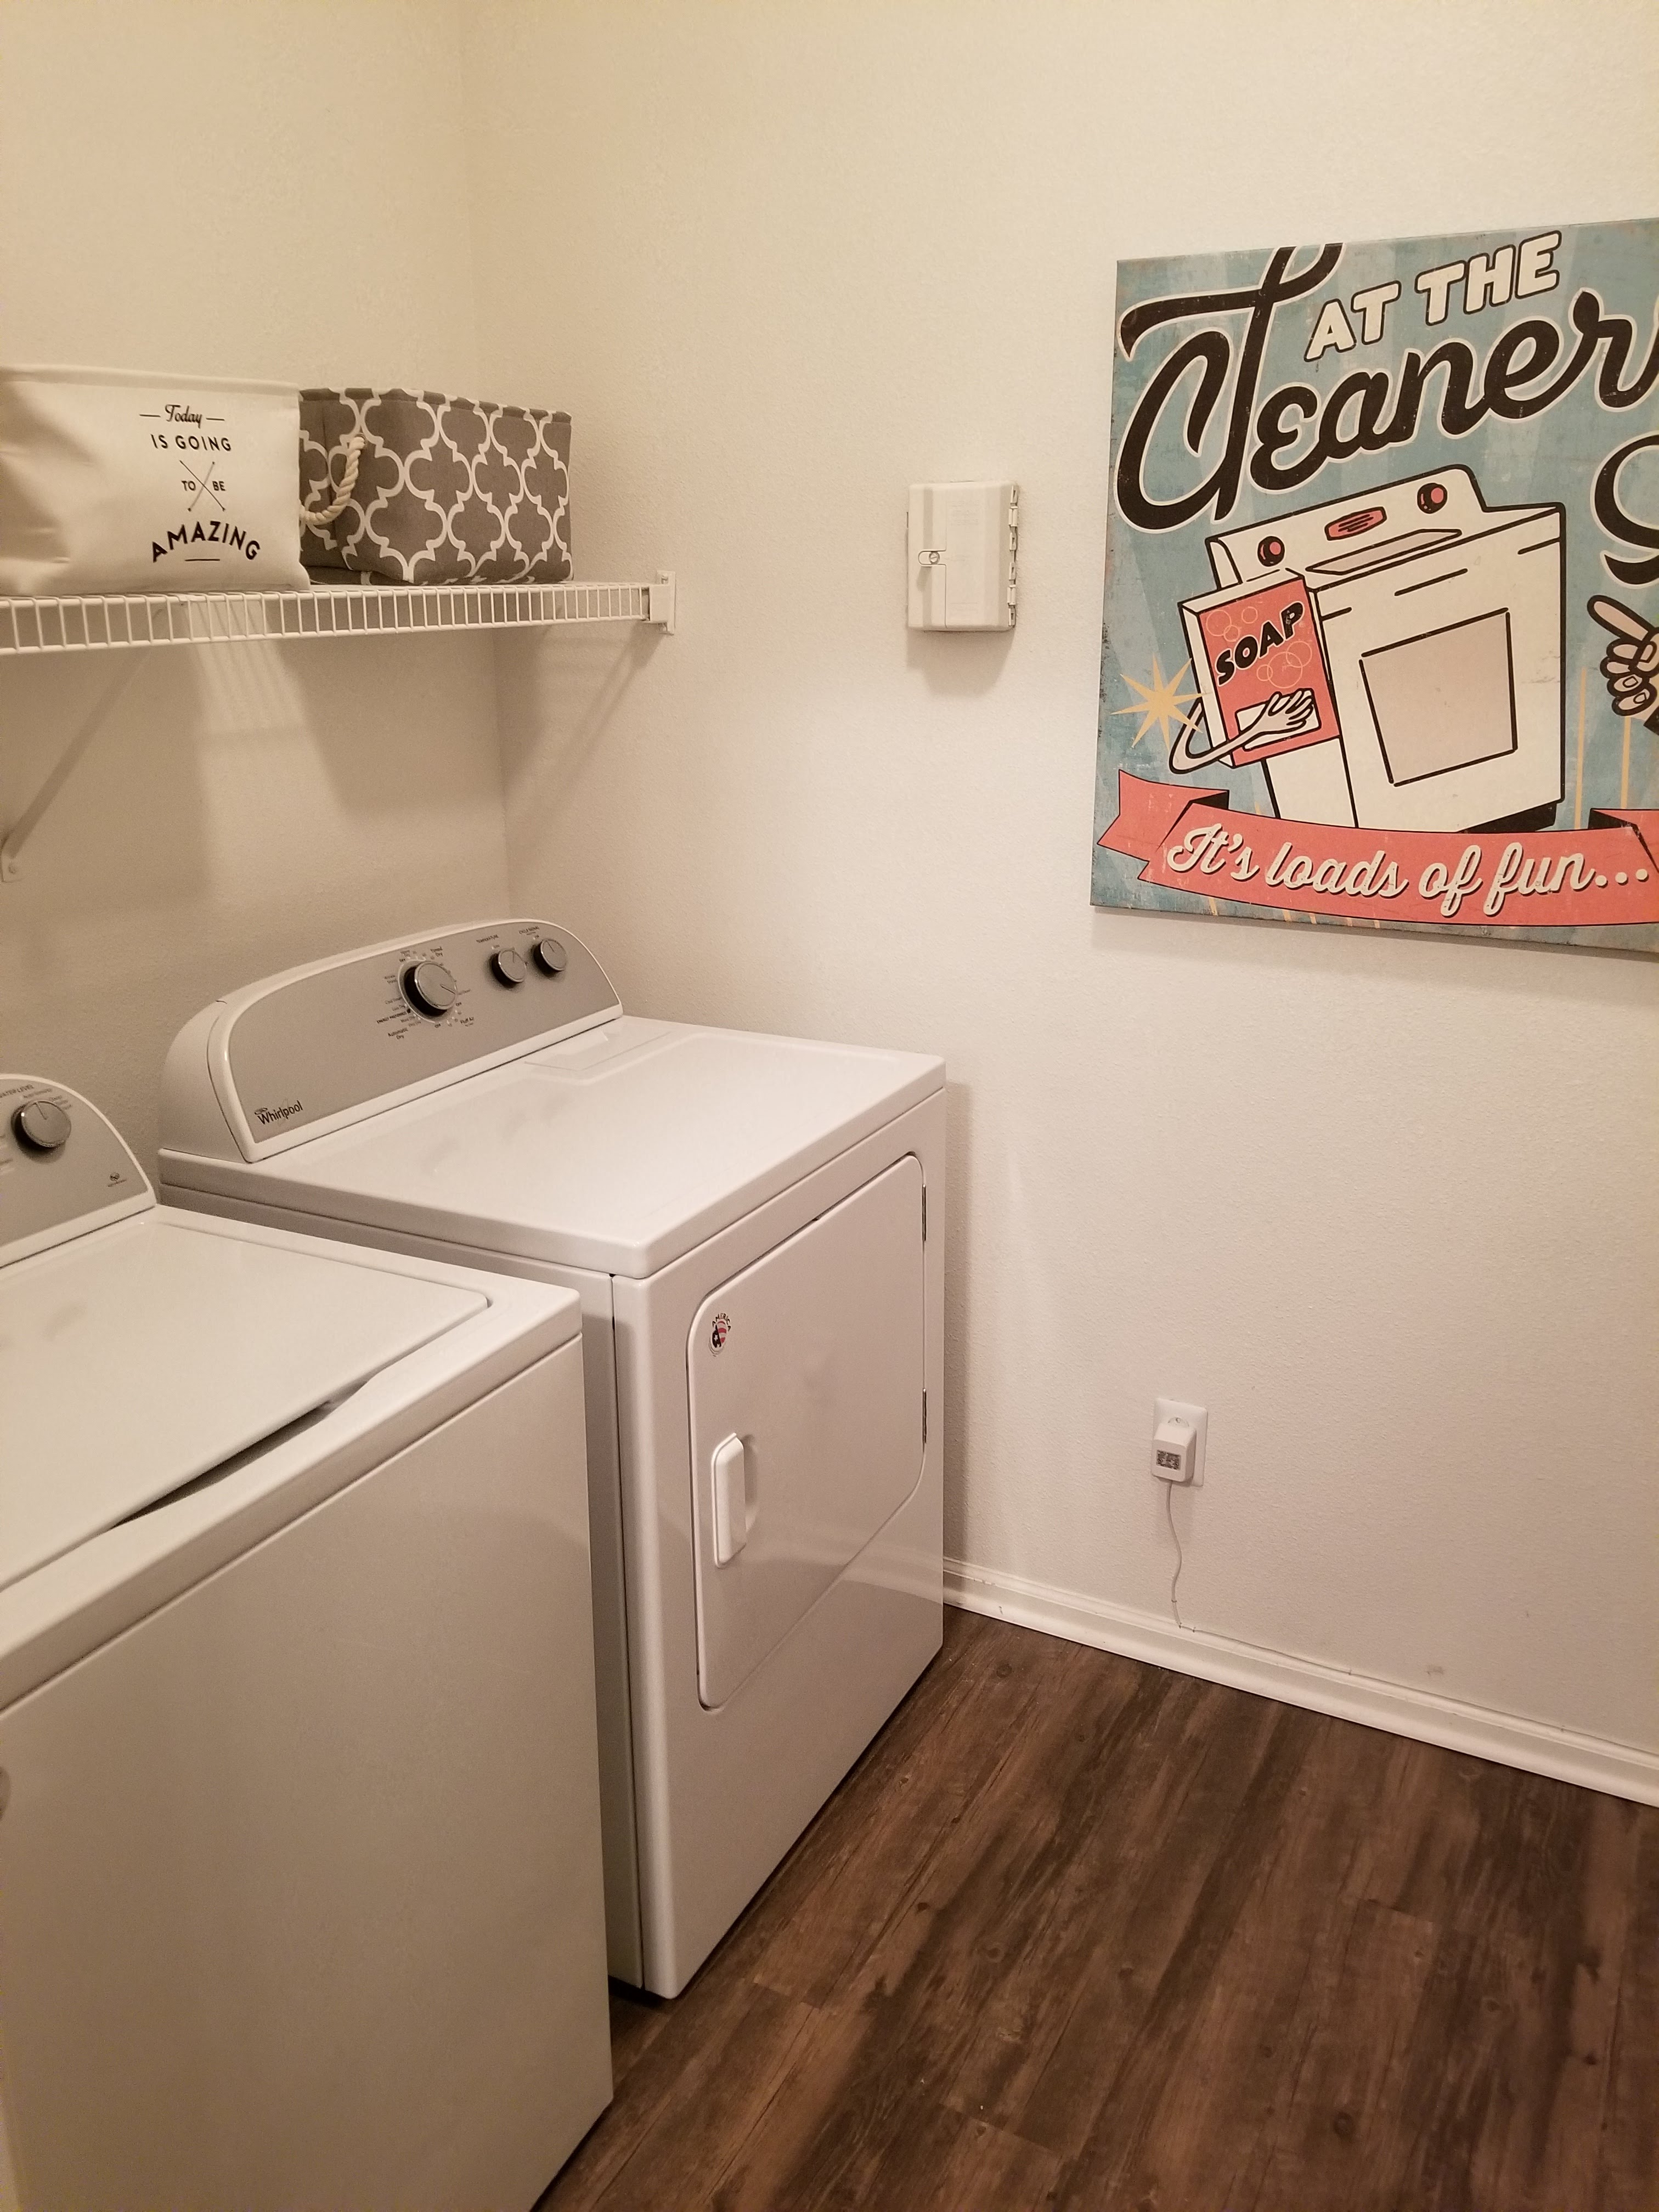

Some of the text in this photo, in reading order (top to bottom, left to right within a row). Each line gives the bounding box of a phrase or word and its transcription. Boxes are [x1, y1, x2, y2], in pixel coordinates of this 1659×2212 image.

[1304, 230, 1562, 362] AT THE
[1114, 241, 1659, 531] Cleaner
[165, 404, 202, 428] Today
[150, 433, 232, 452] IS GOING
[181, 480, 226, 492] TO BE
[151, 520, 261, 563] AMAZING
[1215, 601, 1305, 686] SOAP
[1167, 823, 1649, 917] It's loads of fun...
[257, 1099, 303, 1125] Whirlpool
